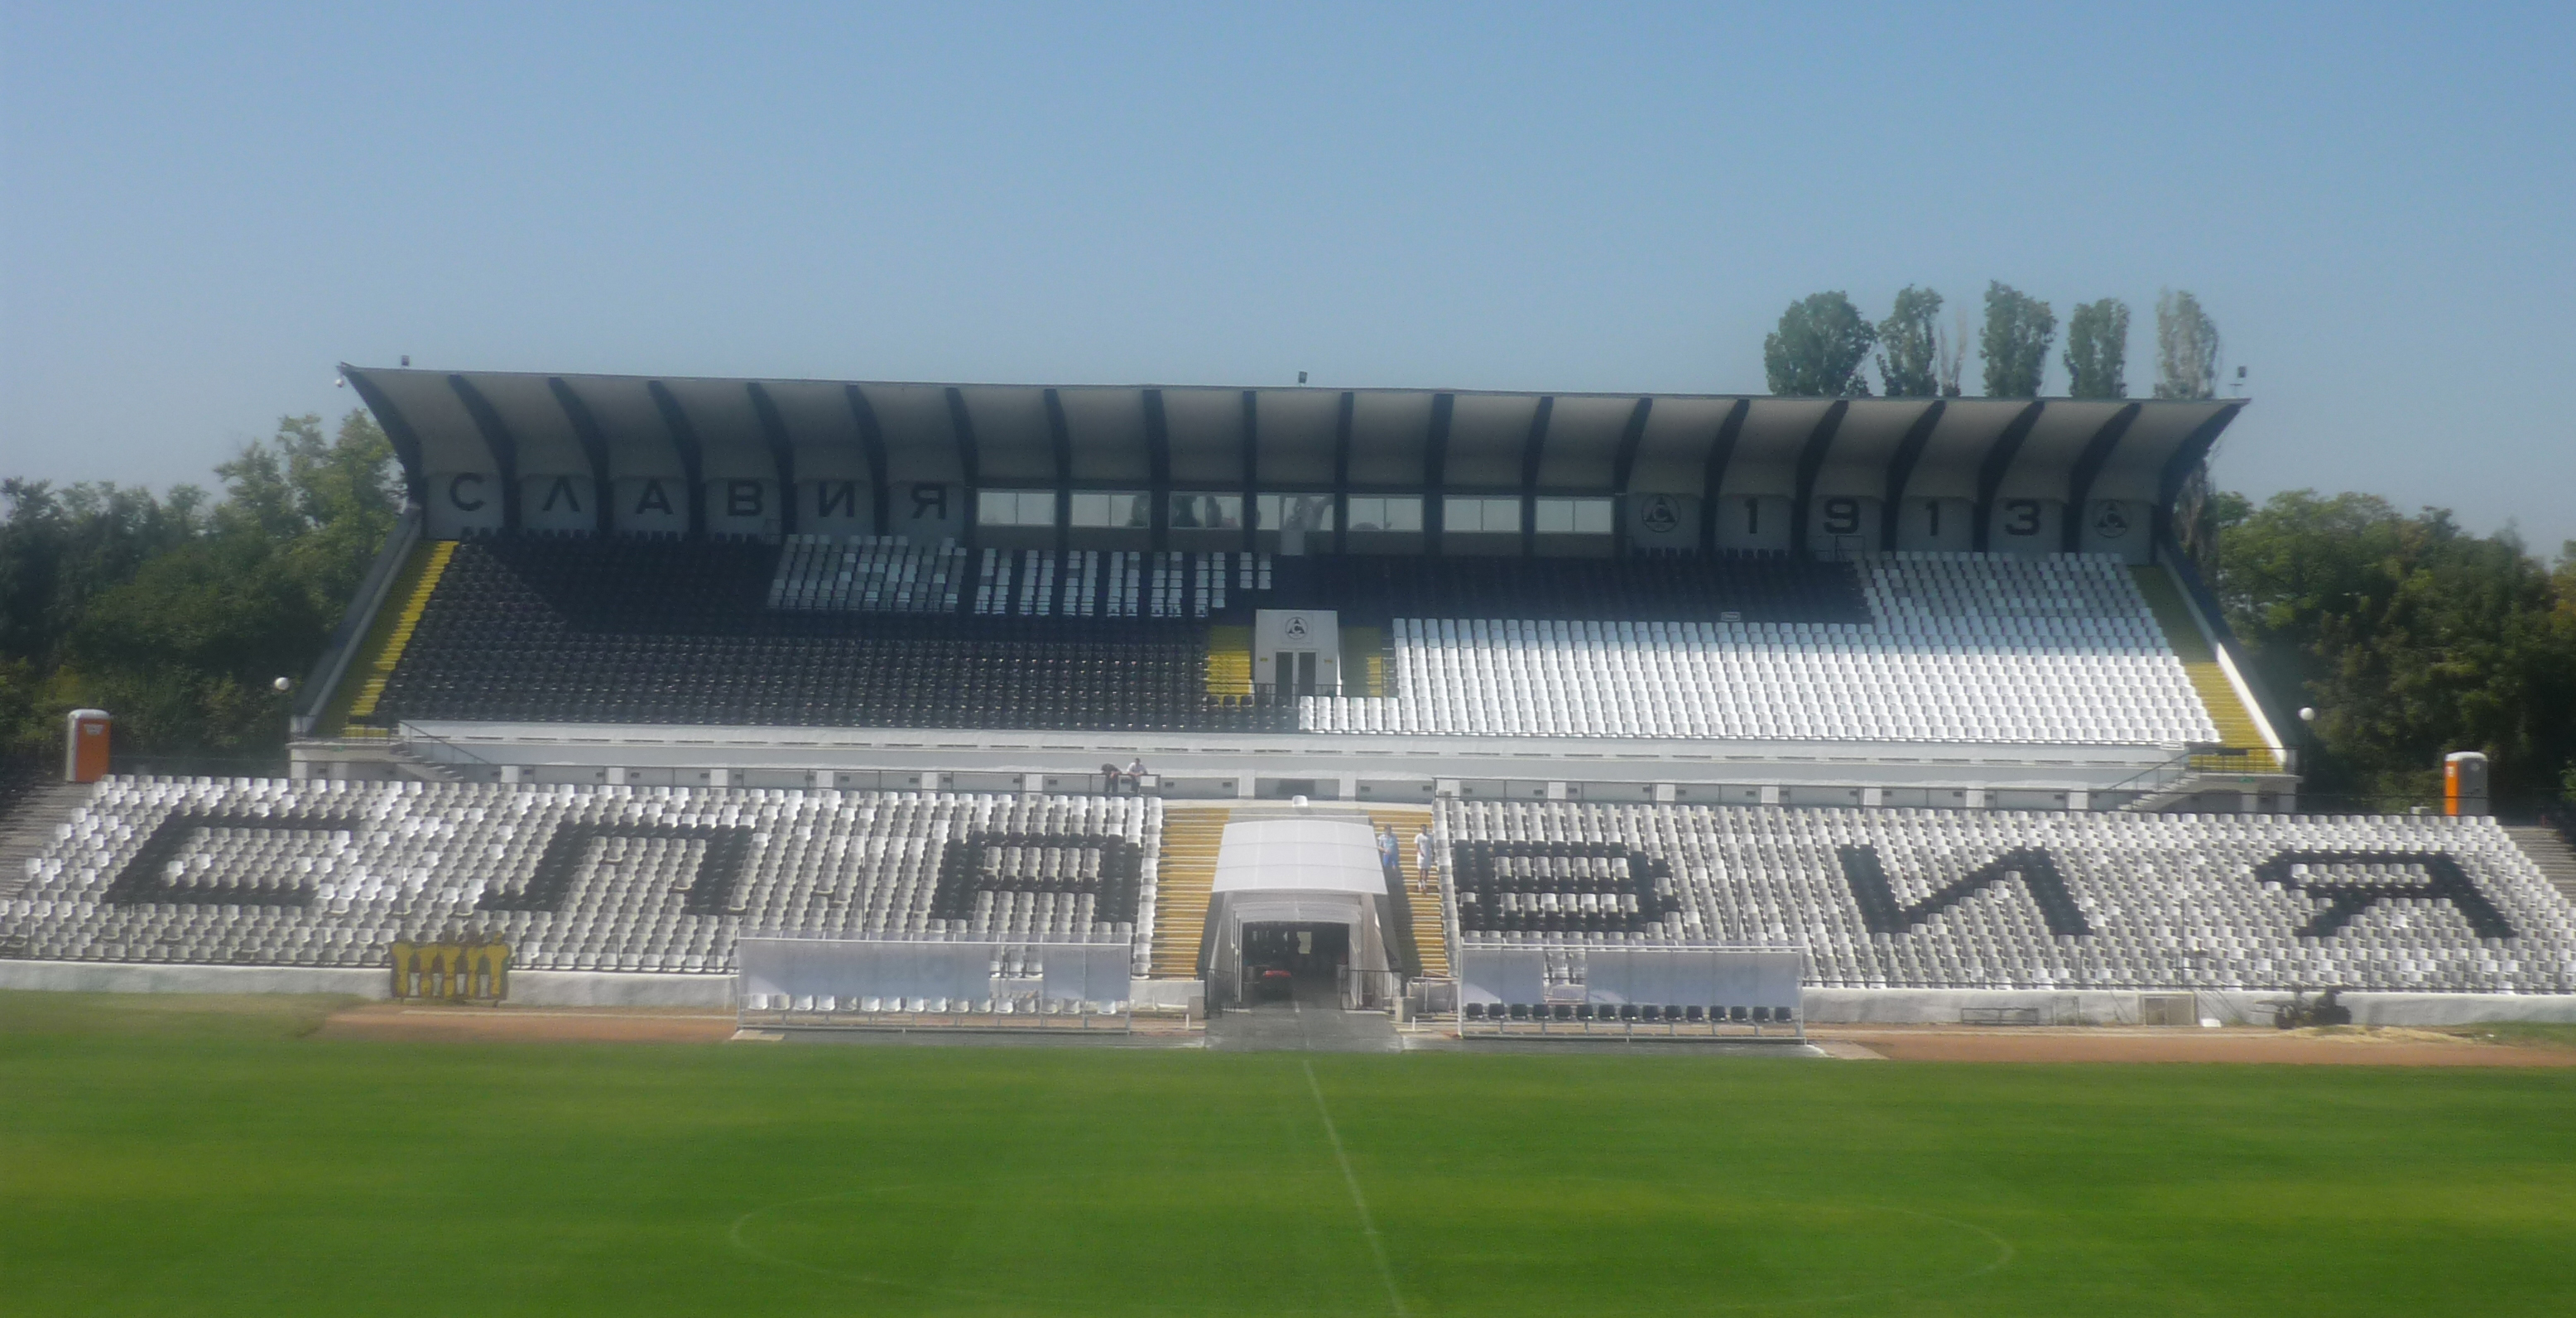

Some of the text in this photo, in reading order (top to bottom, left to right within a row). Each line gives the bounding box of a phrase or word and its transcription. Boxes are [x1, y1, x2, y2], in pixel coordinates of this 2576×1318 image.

[449, 472, 947, 519] СЛАВИЯ
[1744, 497, 2040, 537] 1913
[103, 810, 2516, 939] СЛАВИЯ
